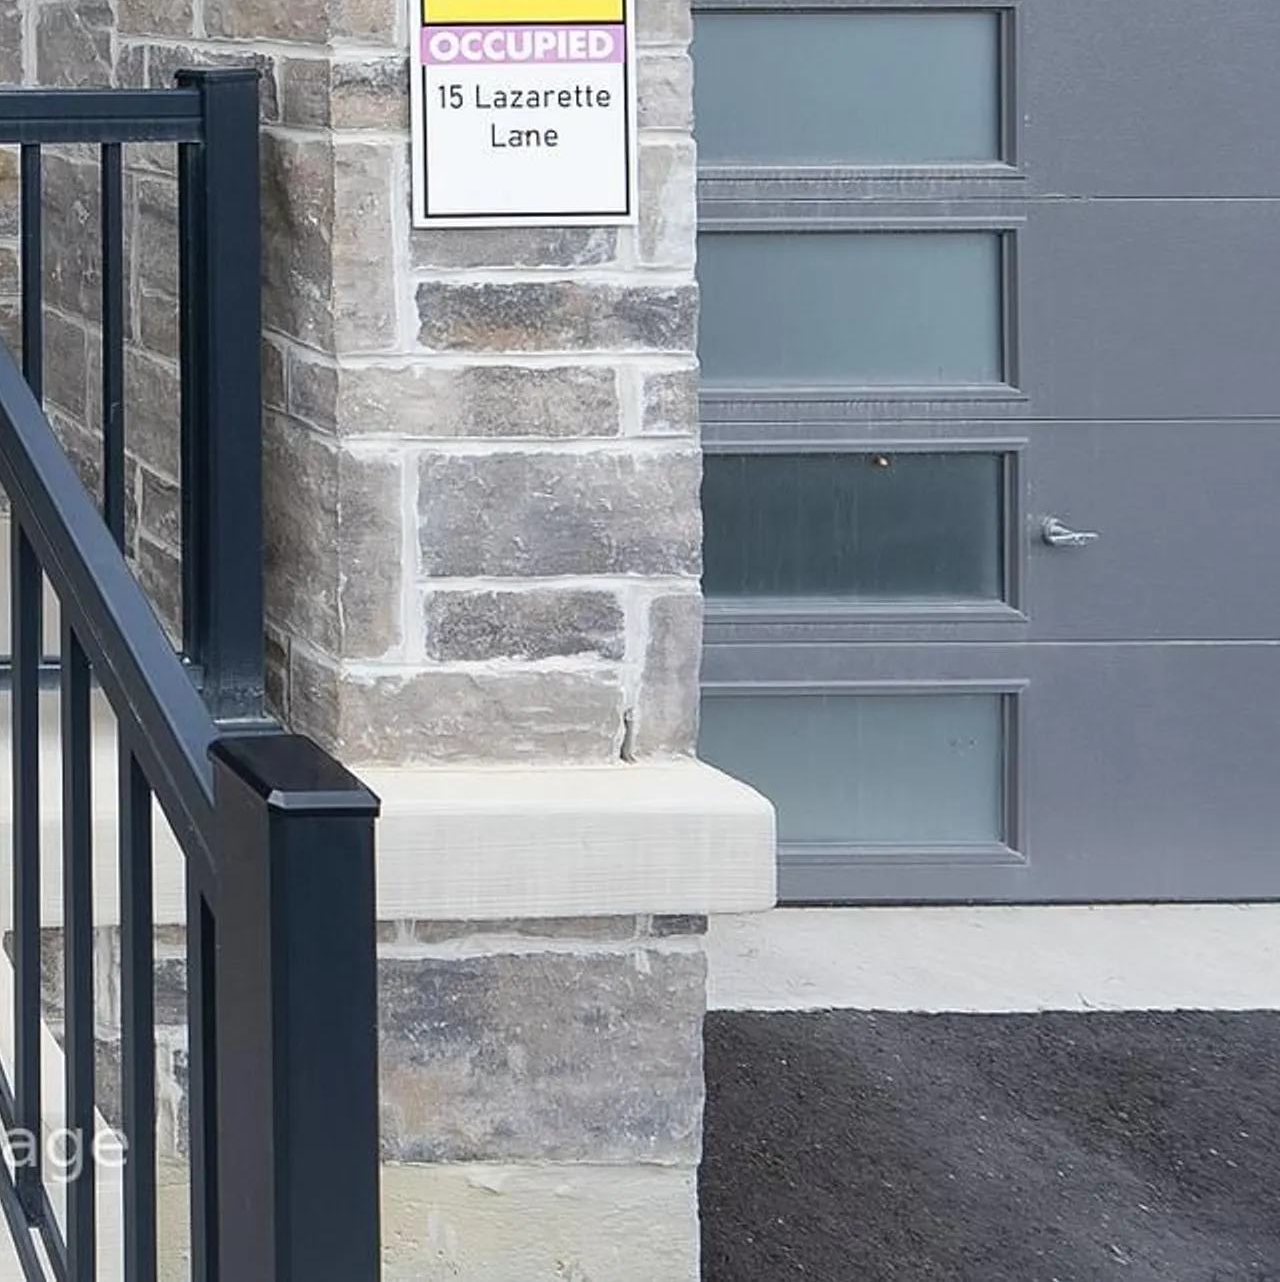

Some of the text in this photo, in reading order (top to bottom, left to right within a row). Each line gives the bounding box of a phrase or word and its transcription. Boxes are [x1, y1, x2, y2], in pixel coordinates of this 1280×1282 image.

[429, 30, 615, 62] OCCUPIED
[438, 84, 612, 110] 15 Lazarette
[490, 123, 559, 148] Lane
